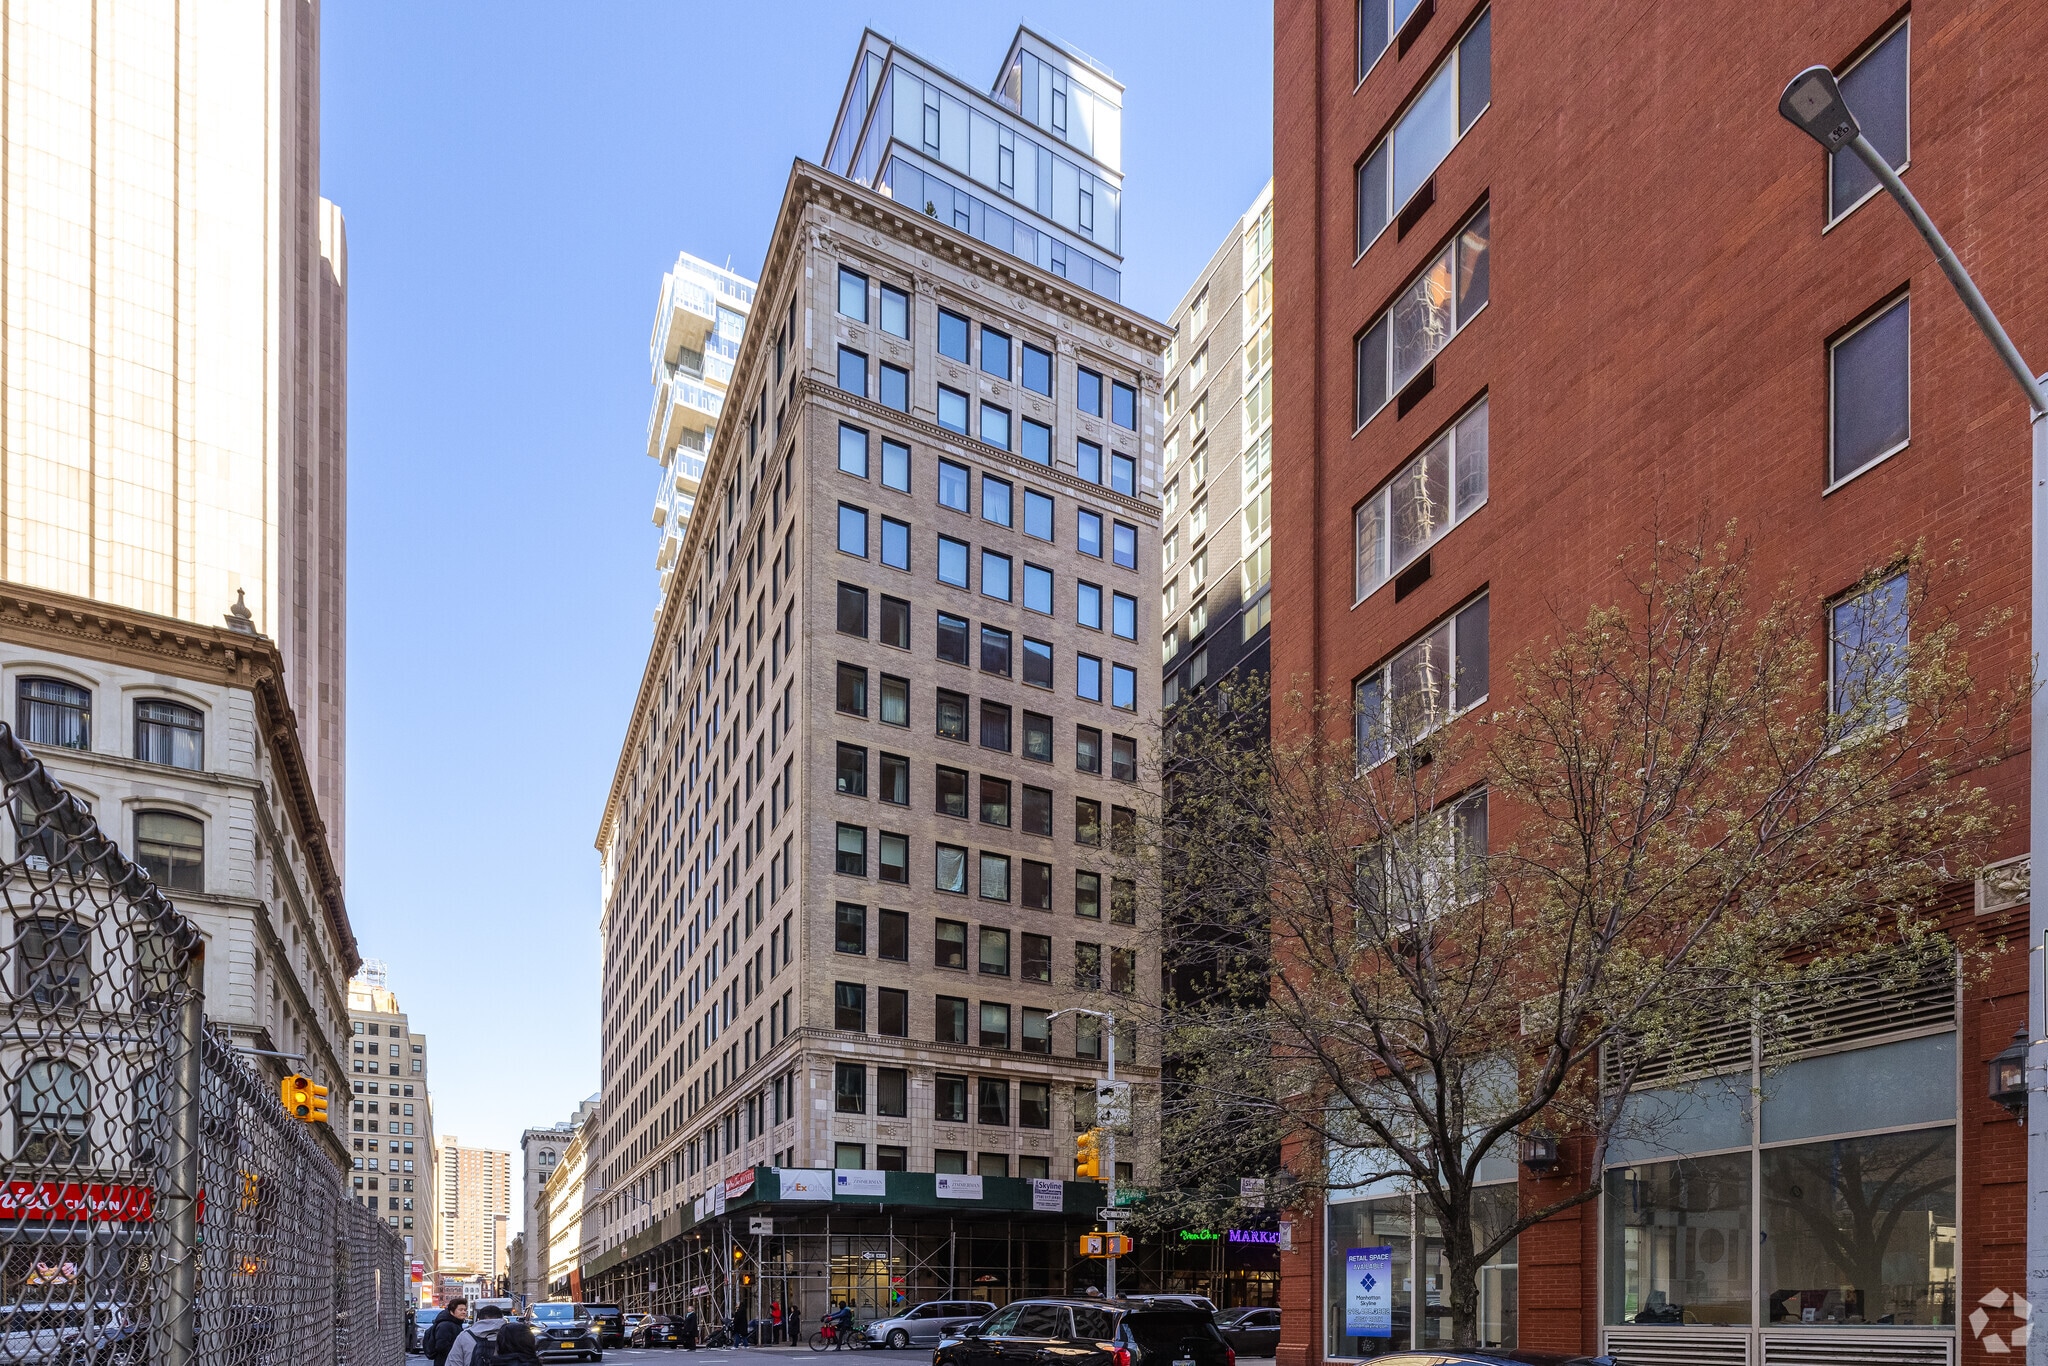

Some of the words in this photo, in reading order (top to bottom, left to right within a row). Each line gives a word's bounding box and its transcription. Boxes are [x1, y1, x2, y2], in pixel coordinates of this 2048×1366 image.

[782, 1182, 807, 1192] FedEx
[1039, 1181, 1062, 1191] Skyline
[64, 1199, 120, 1211] CUBAN
[1353, 1262, 1384, 1270] AVAILABLE
